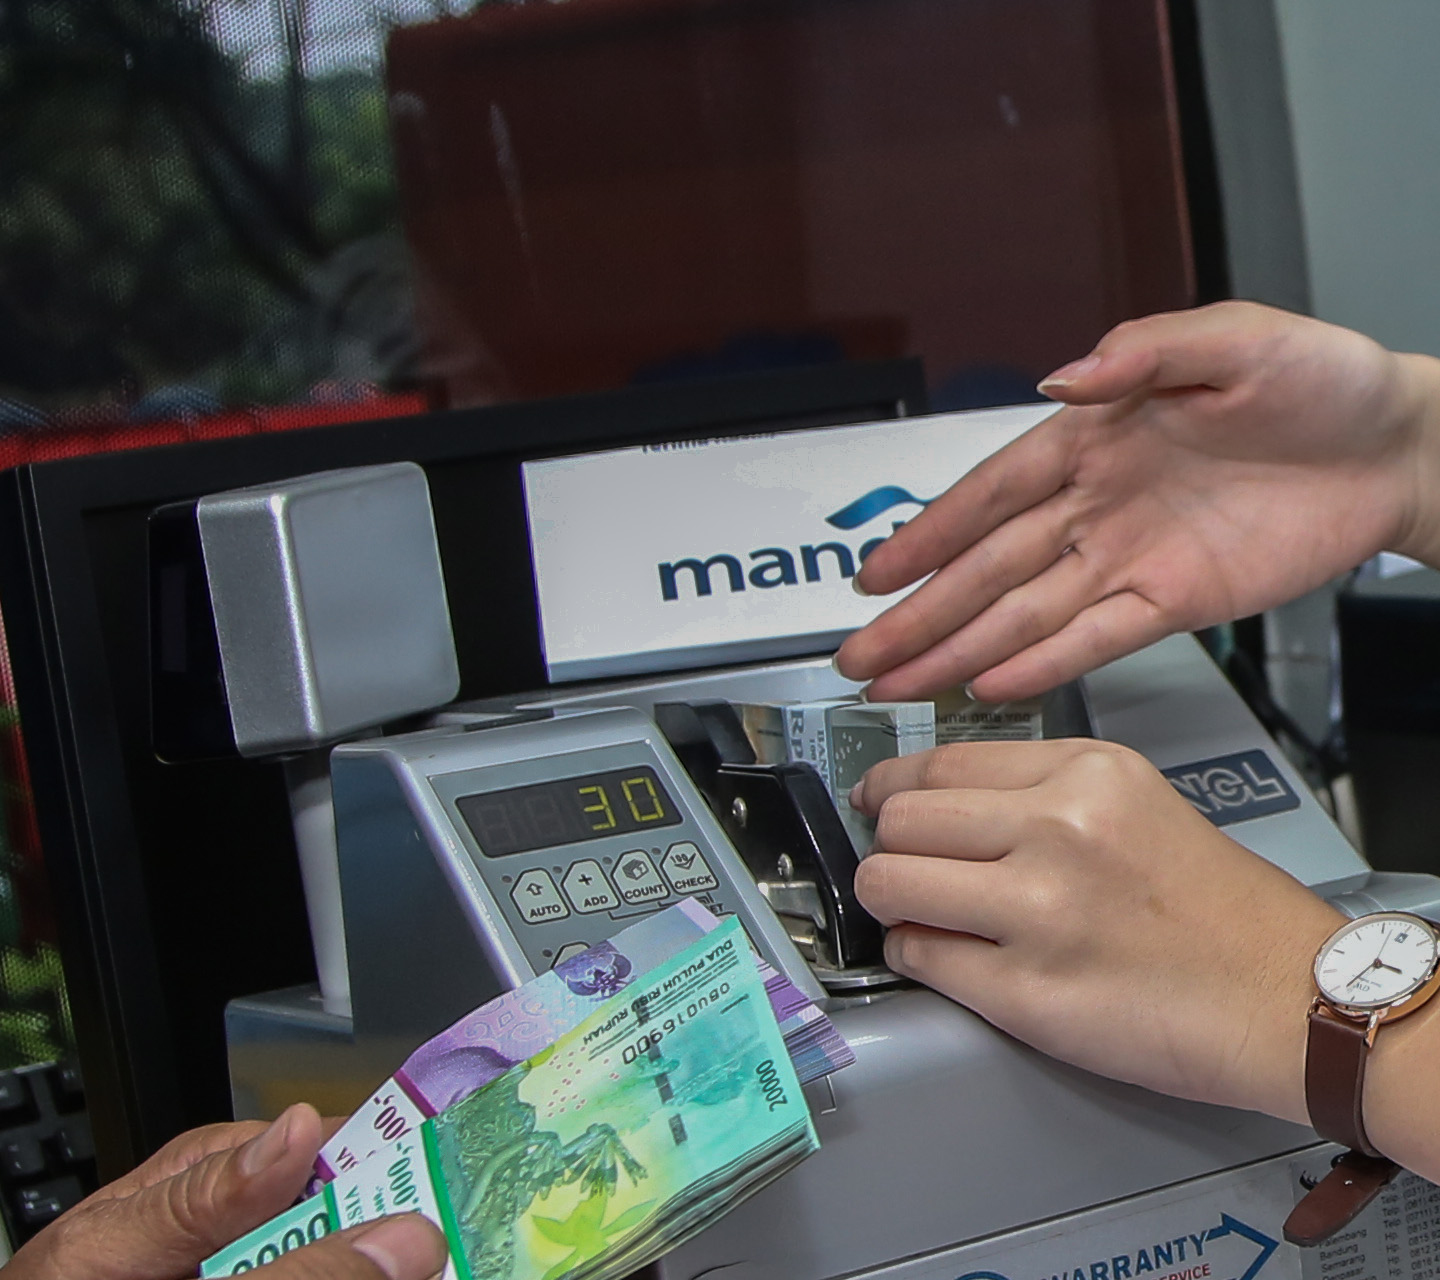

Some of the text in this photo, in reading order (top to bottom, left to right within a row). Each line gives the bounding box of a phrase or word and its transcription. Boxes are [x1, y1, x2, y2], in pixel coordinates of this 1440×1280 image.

[579, 776, 667, 833] 30
[624, 884, 664, 900] COUNT
[674, 875, 714, 890] CHECK
[529, 904, 561, 918] AUTO
[583, 895, 609, 908] ADD
[707, 938, 734, 962] DUA
[663, 959, 706, 993] PULUH
[582, 1007, 628, 1046] RUPIAH
[755, 1058, 789, 1113] 20000
[1319, 1243, 1358, 1261] Bandung
[1321, 1253, 1366, 1273] Semarang
